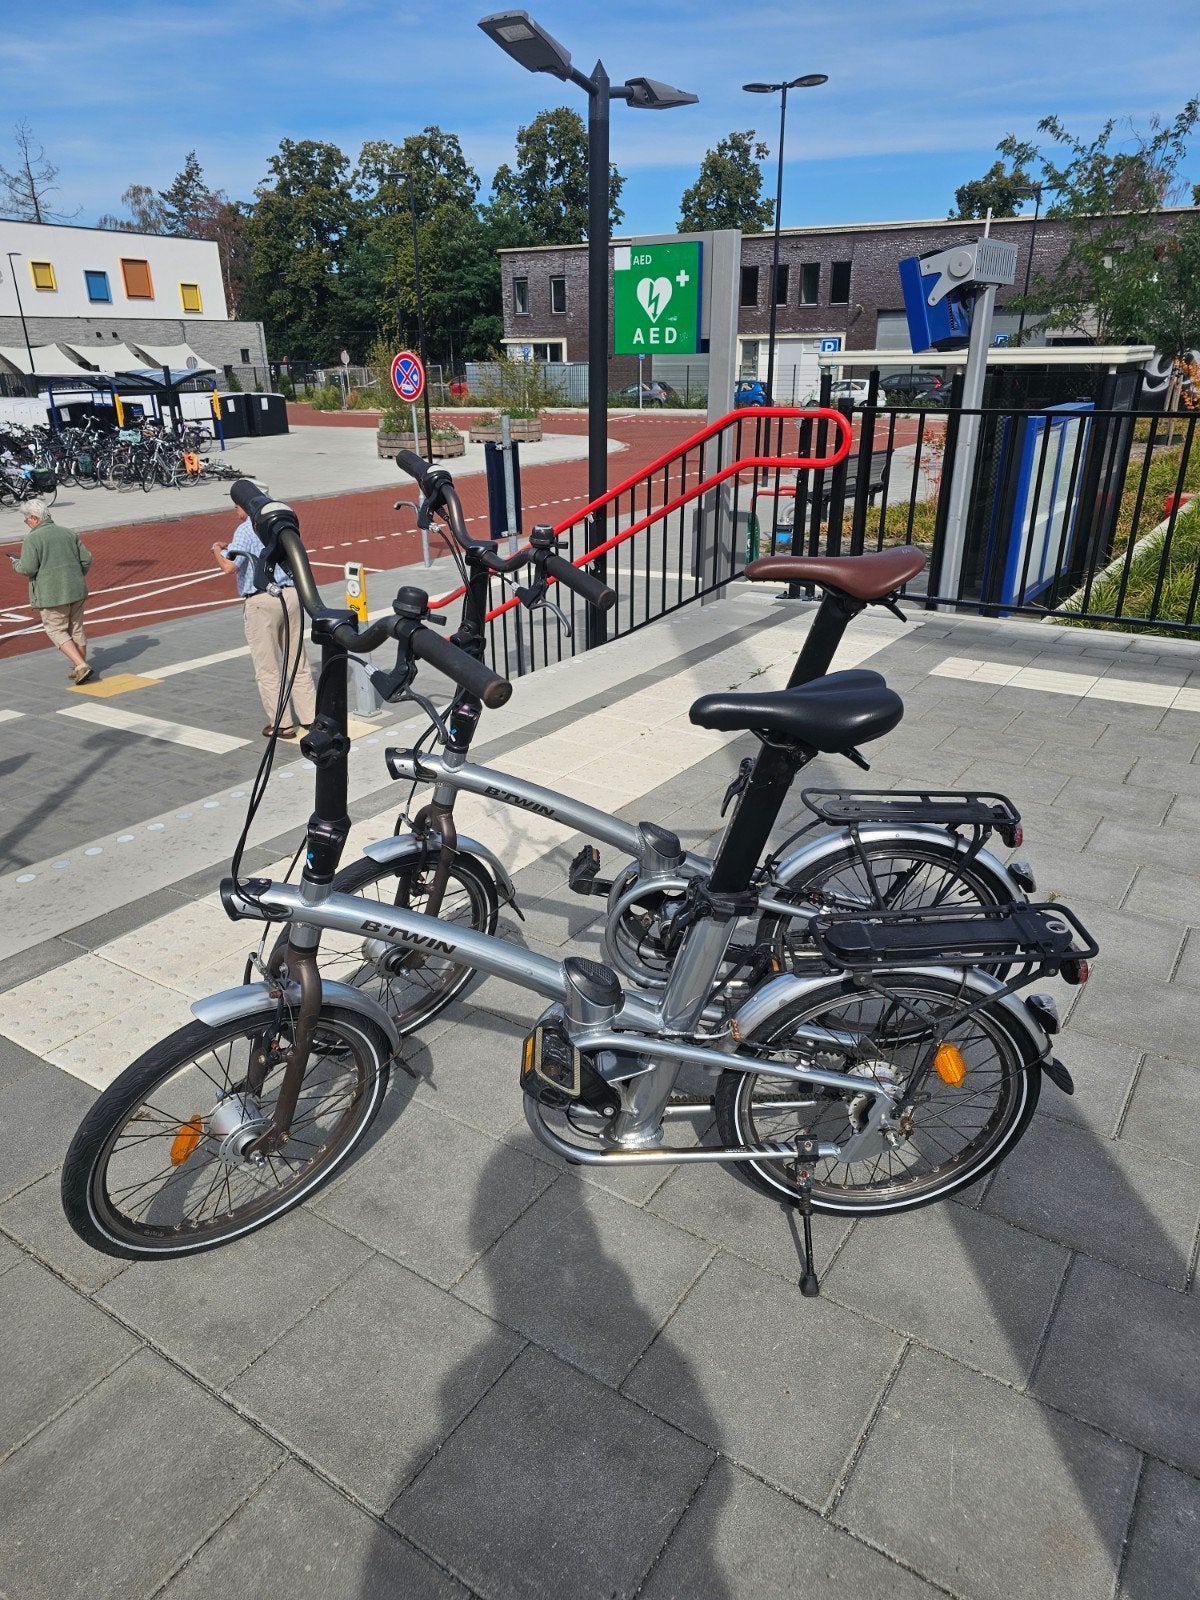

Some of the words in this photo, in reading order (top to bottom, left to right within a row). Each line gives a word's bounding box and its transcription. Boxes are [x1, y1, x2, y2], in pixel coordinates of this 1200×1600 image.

[632, 254, 652, 266] AED
[632, 326, 678, 345] AED
[824, 341, 835, 352] P
